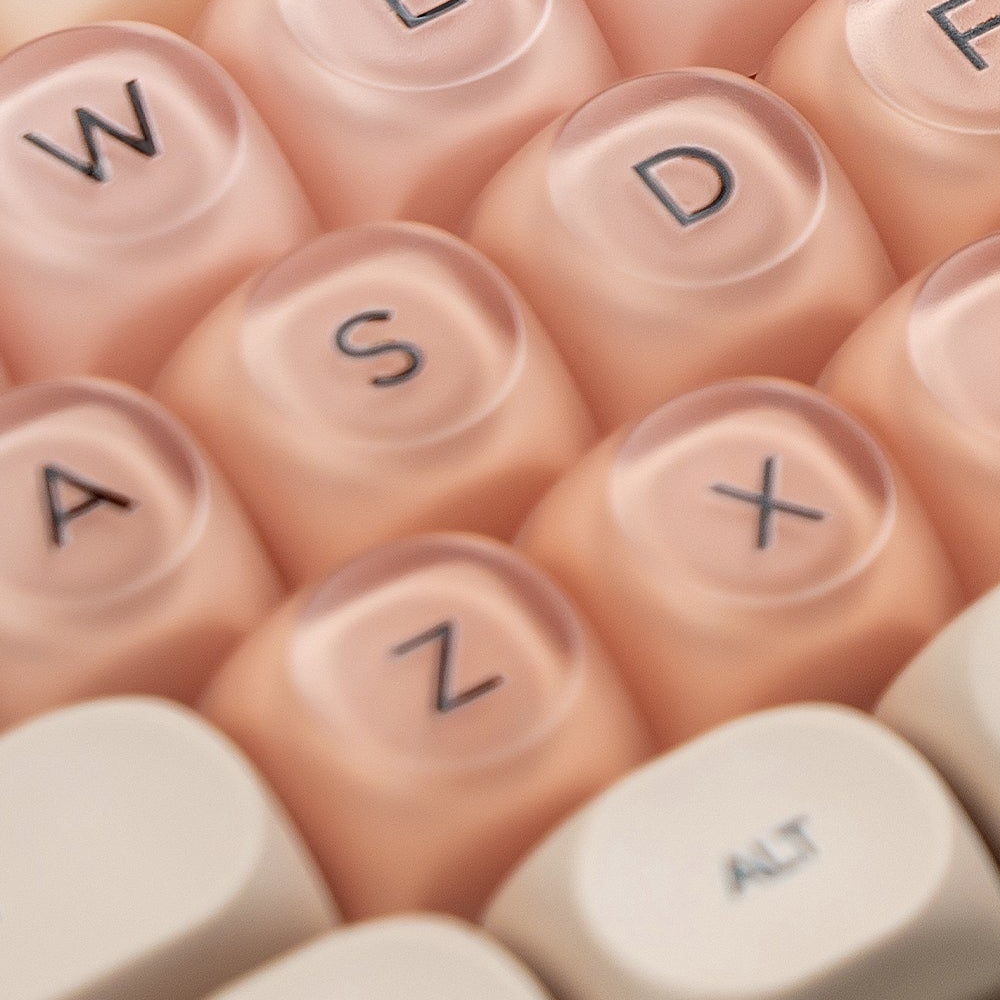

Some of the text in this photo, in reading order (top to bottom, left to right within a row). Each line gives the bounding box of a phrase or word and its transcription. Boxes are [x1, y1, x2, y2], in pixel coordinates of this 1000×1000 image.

[23, 79, 157, 183] W
[632, 147, 734, 226] D
[335, 311, 424, 388] S
[41, 465, 135, 548] A
[713, 457, 824, 551] X
[390, 620, 504, 714] Z
[724, 818, 815, 895] ALT
